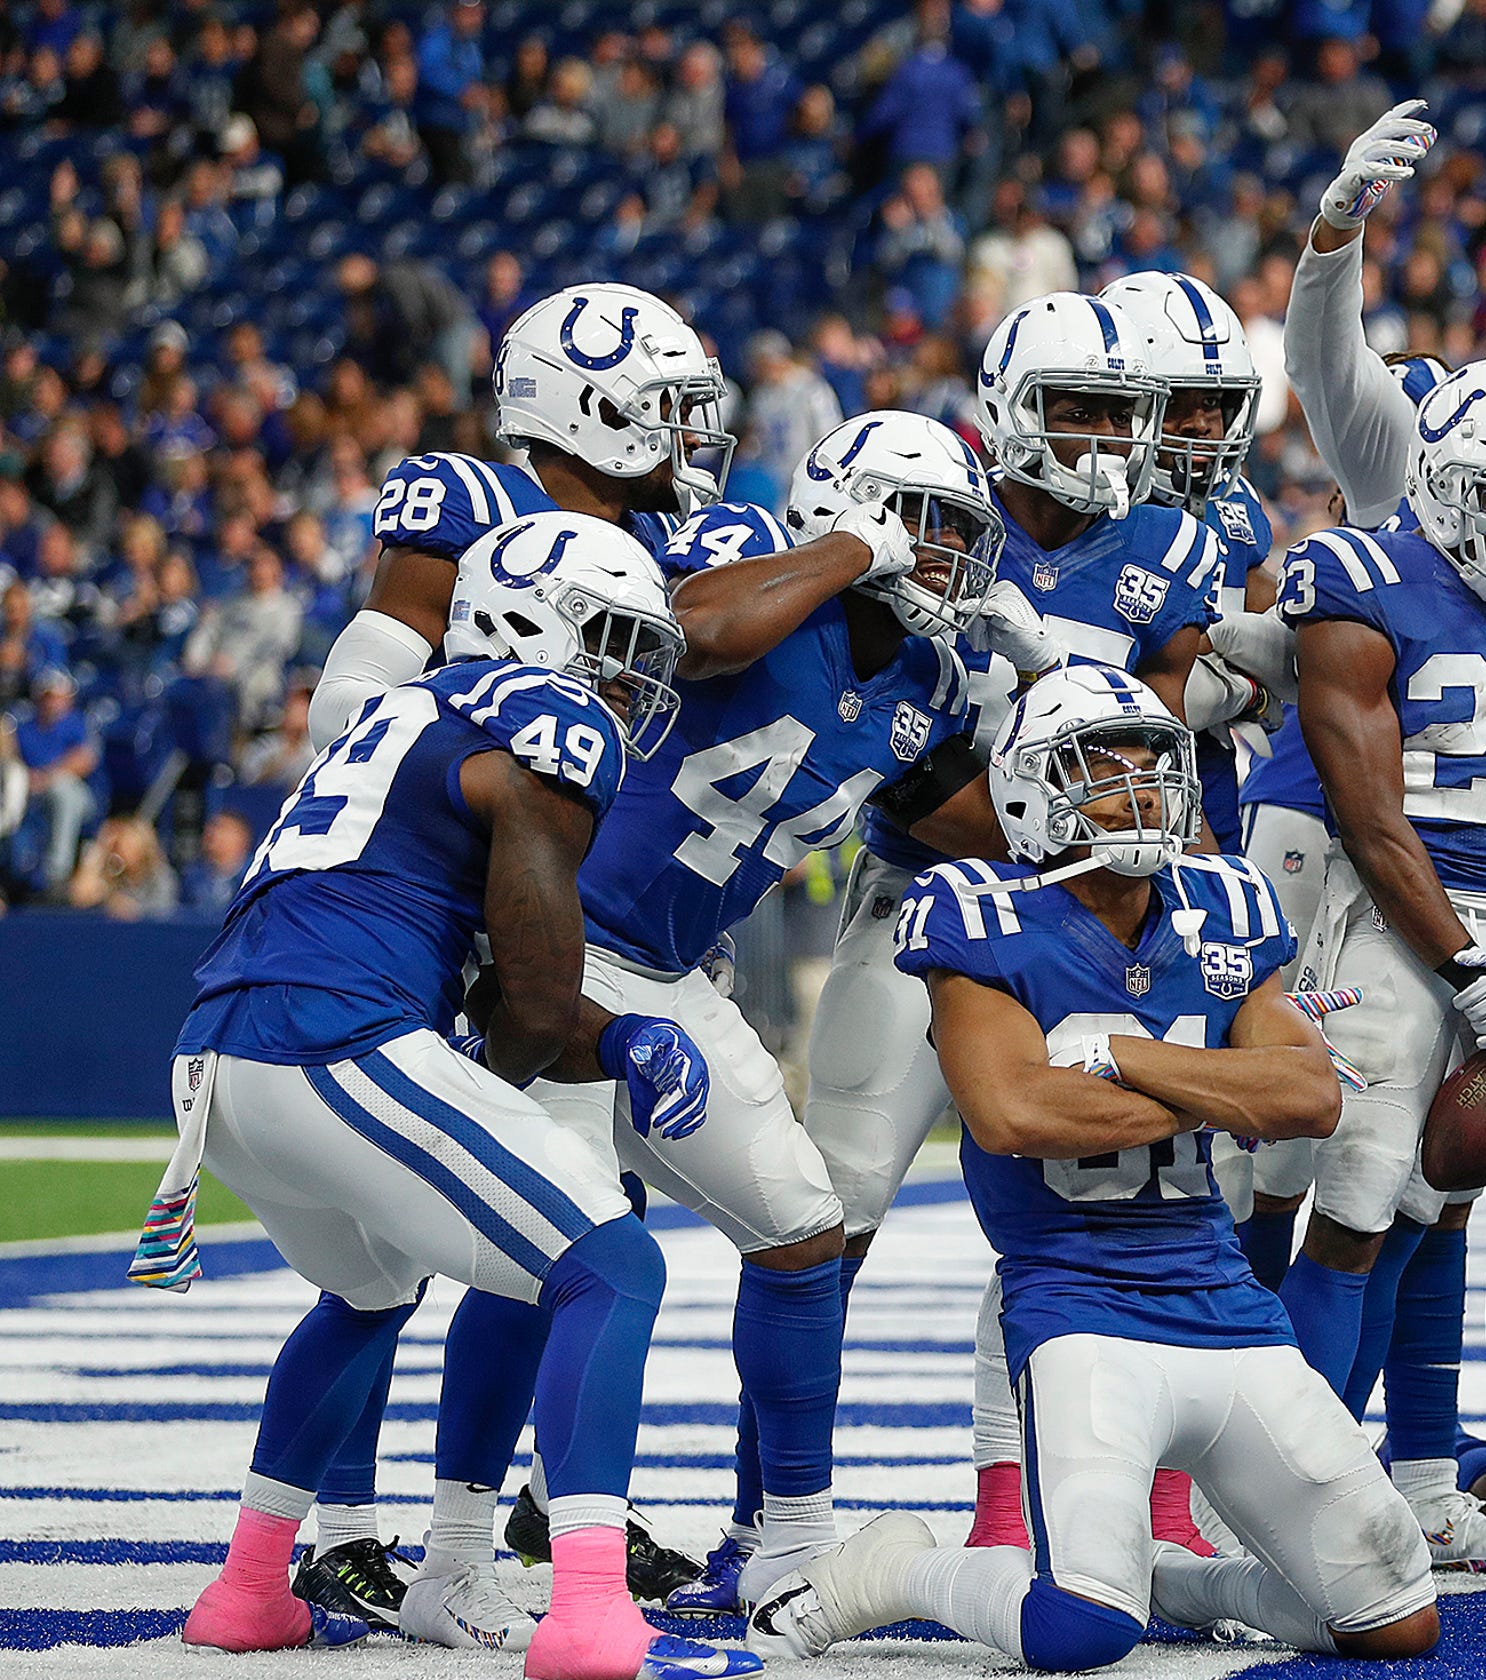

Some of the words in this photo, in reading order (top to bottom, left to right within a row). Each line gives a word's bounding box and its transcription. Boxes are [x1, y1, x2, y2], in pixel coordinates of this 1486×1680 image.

[375, 477, 447, 536] 28
[664, 514, 755, 567] 44
[1119, 565, 1168, 610] 35
[894, 702, 931, 748] 35
[509, 714, 605, 788] 49
[1129, 977, 1148, 990] NFL
[1203, 944, 1250, 979] 35
